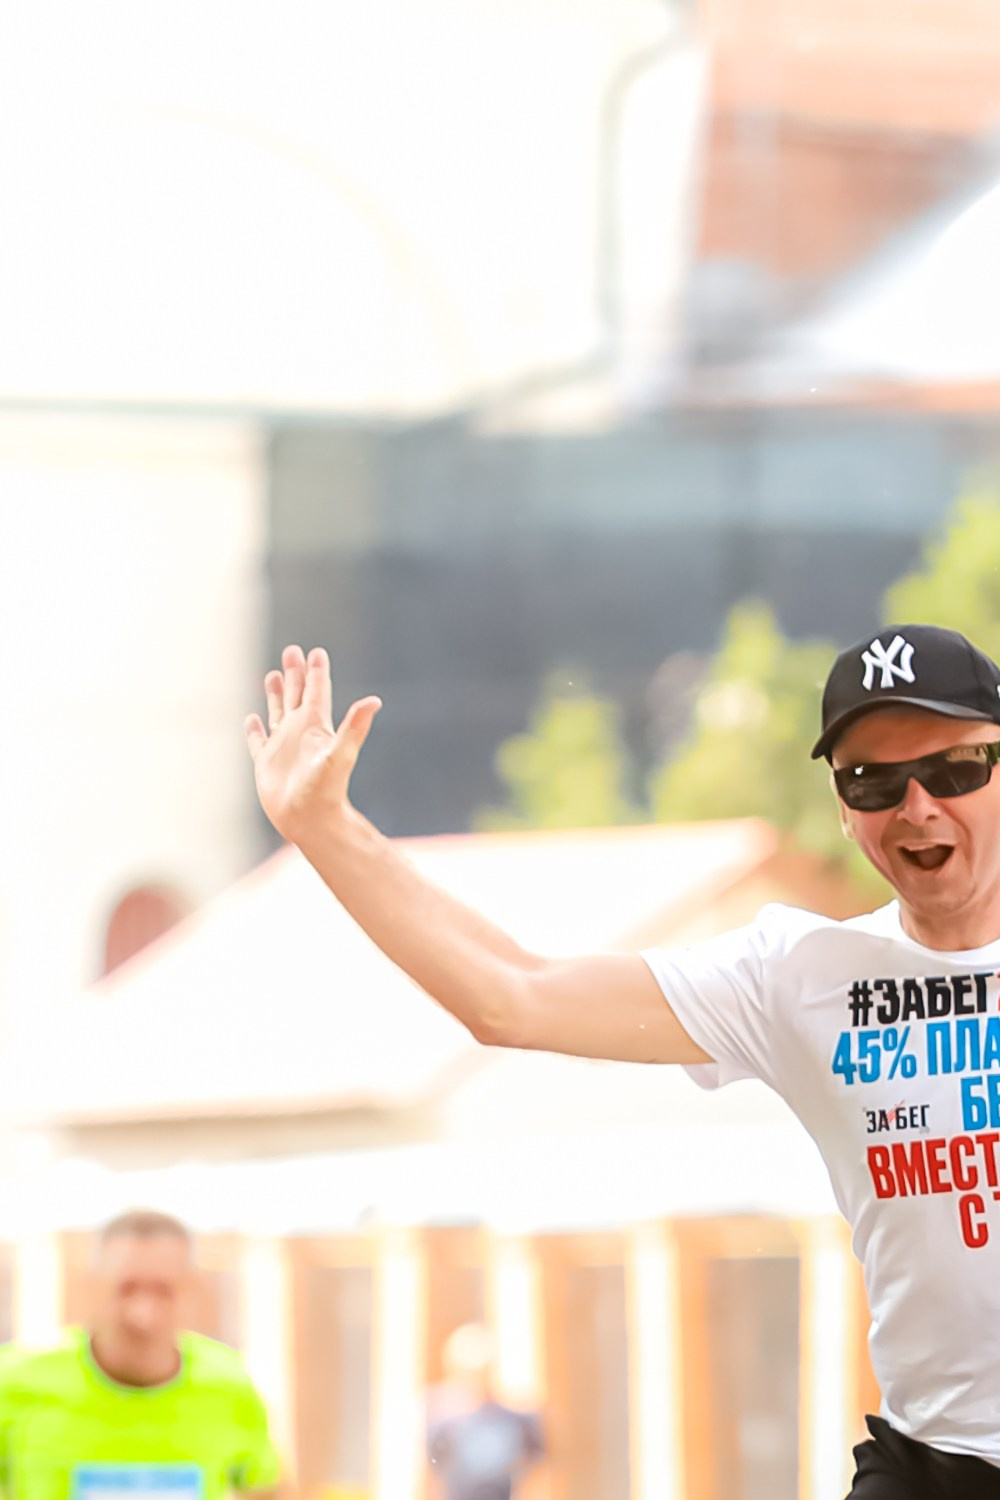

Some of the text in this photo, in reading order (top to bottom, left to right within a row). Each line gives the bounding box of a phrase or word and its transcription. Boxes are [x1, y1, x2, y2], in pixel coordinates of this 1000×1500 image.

[861, 635, 916, 691] NY
[832, 1026, 917, 1085] 45%
[958, 1195, 989, 1248] С
